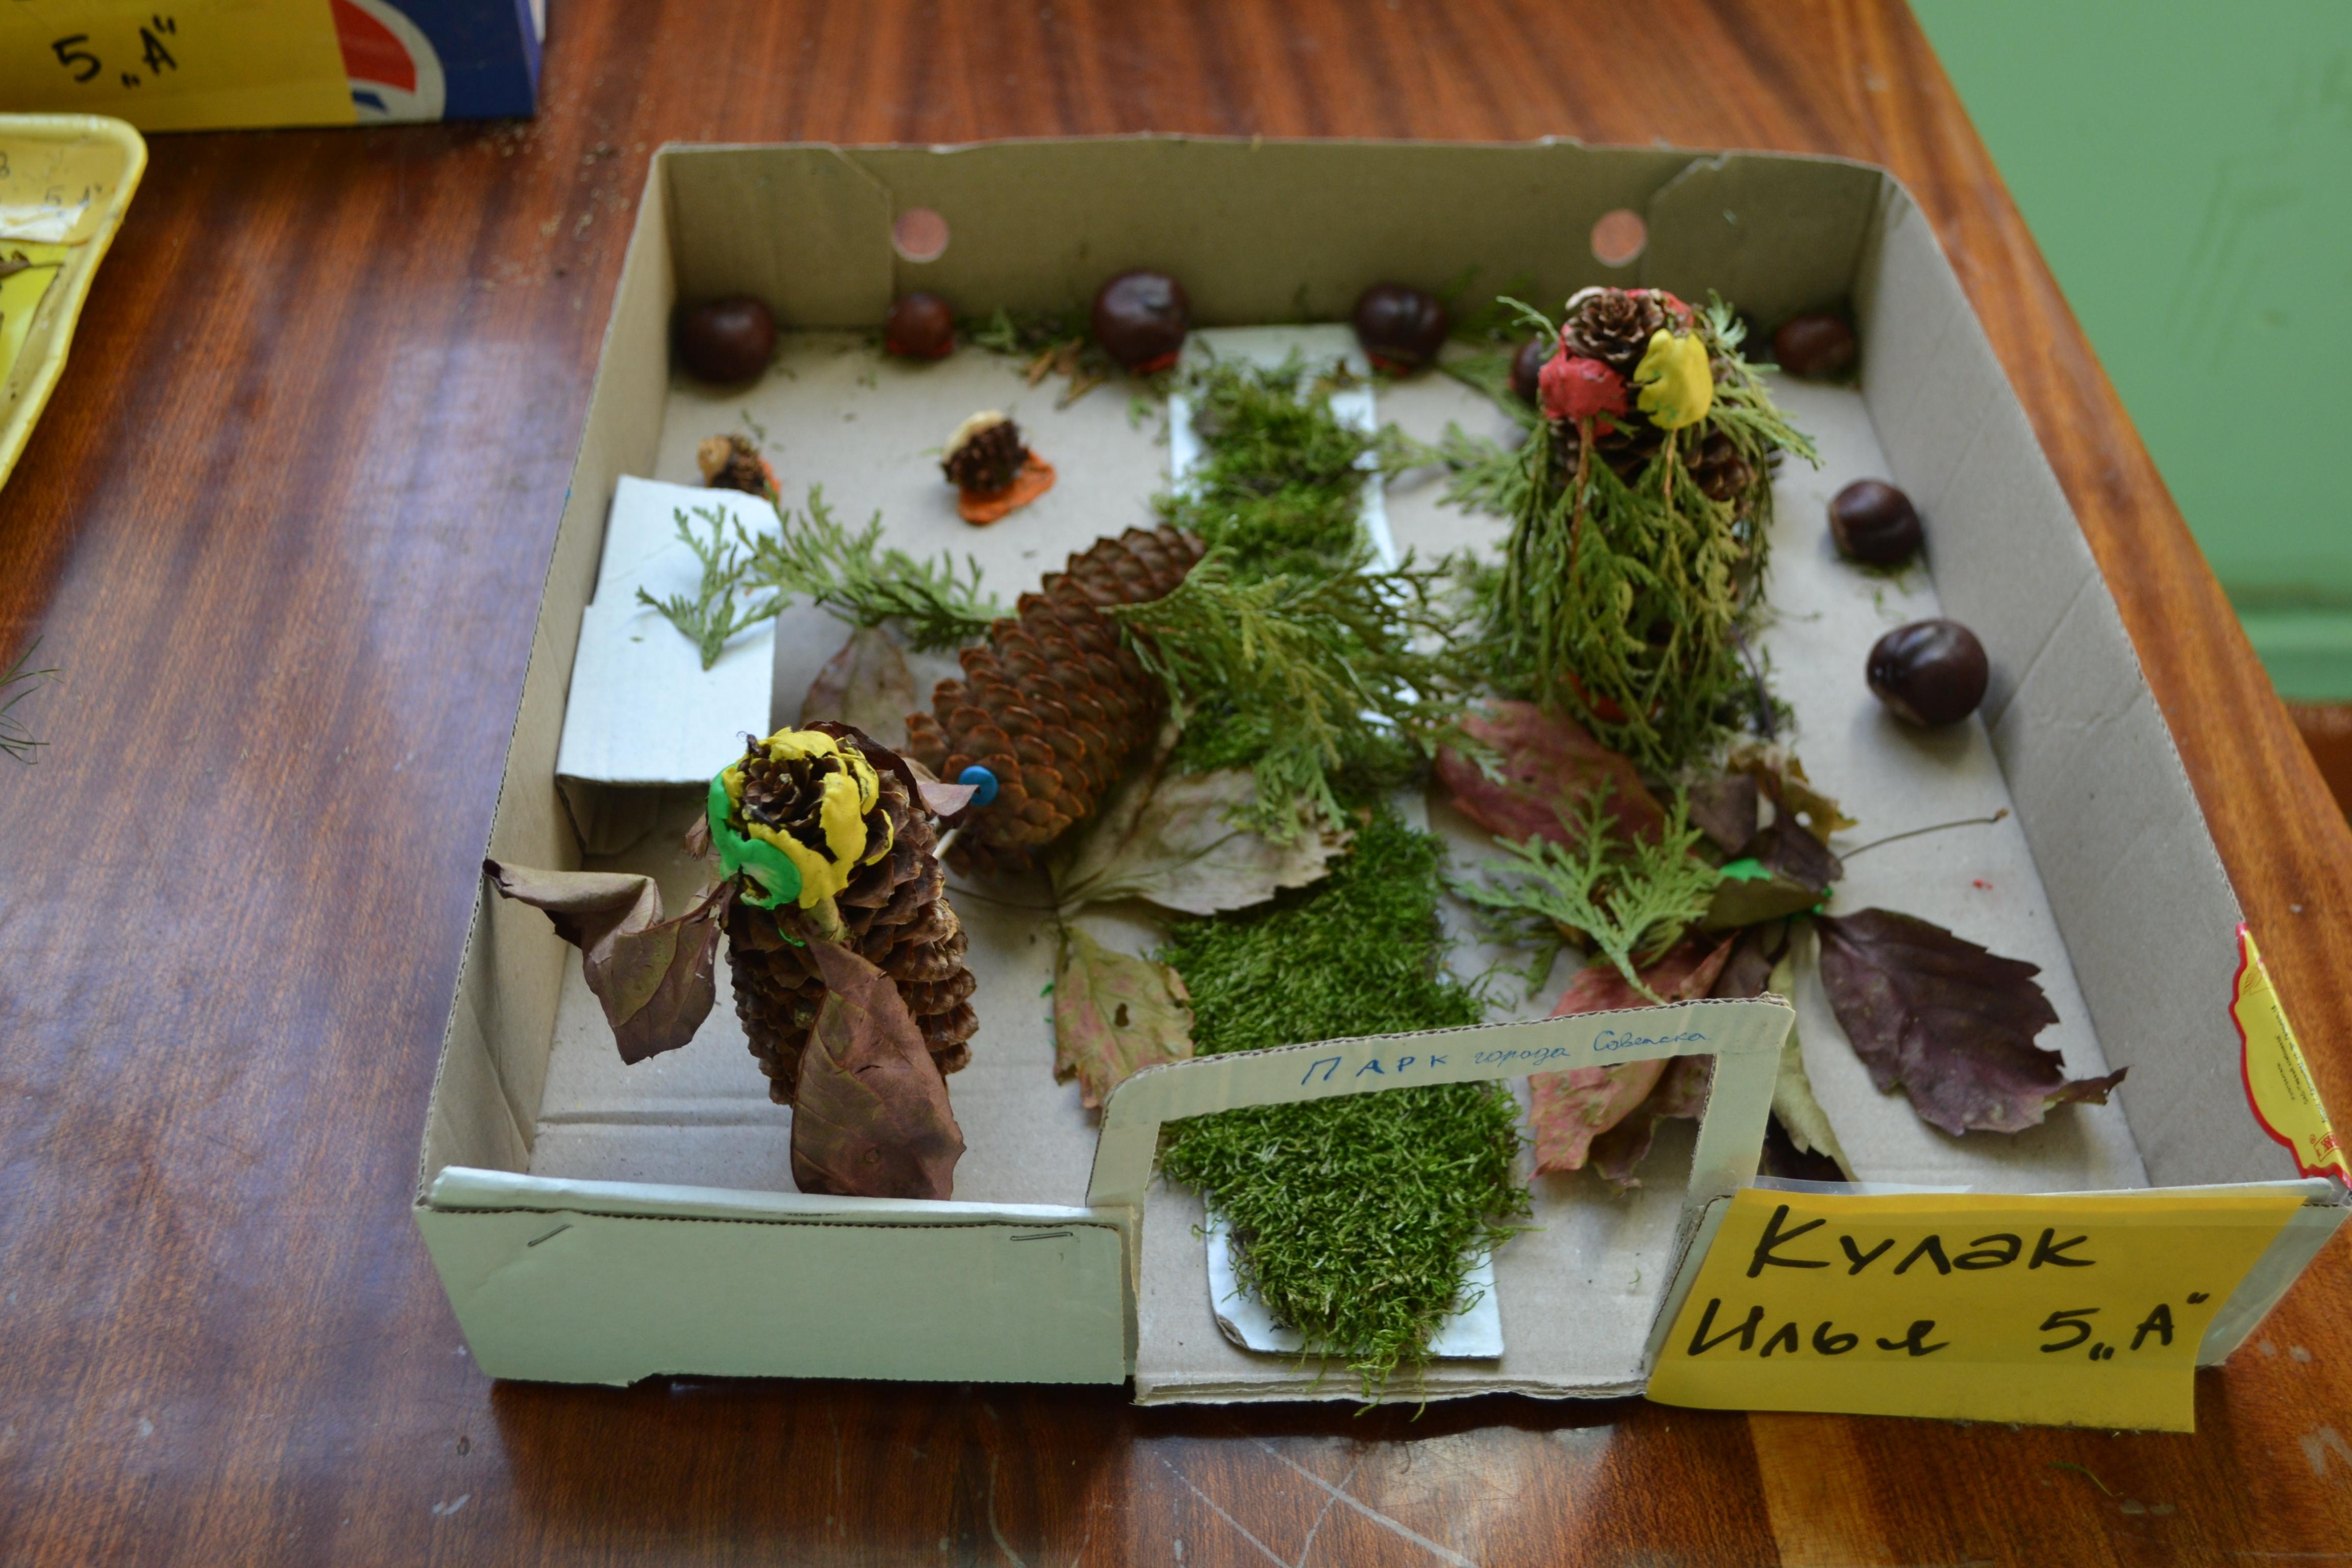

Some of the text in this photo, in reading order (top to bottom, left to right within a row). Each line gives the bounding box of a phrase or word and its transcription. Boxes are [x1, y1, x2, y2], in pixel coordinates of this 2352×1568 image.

[1301, 1030, 1708, 1085] ПАРК города Советска
[1746, 1204, 2096, 1279] Кулак
[1687, 1297, 1949, 1358] Илья
